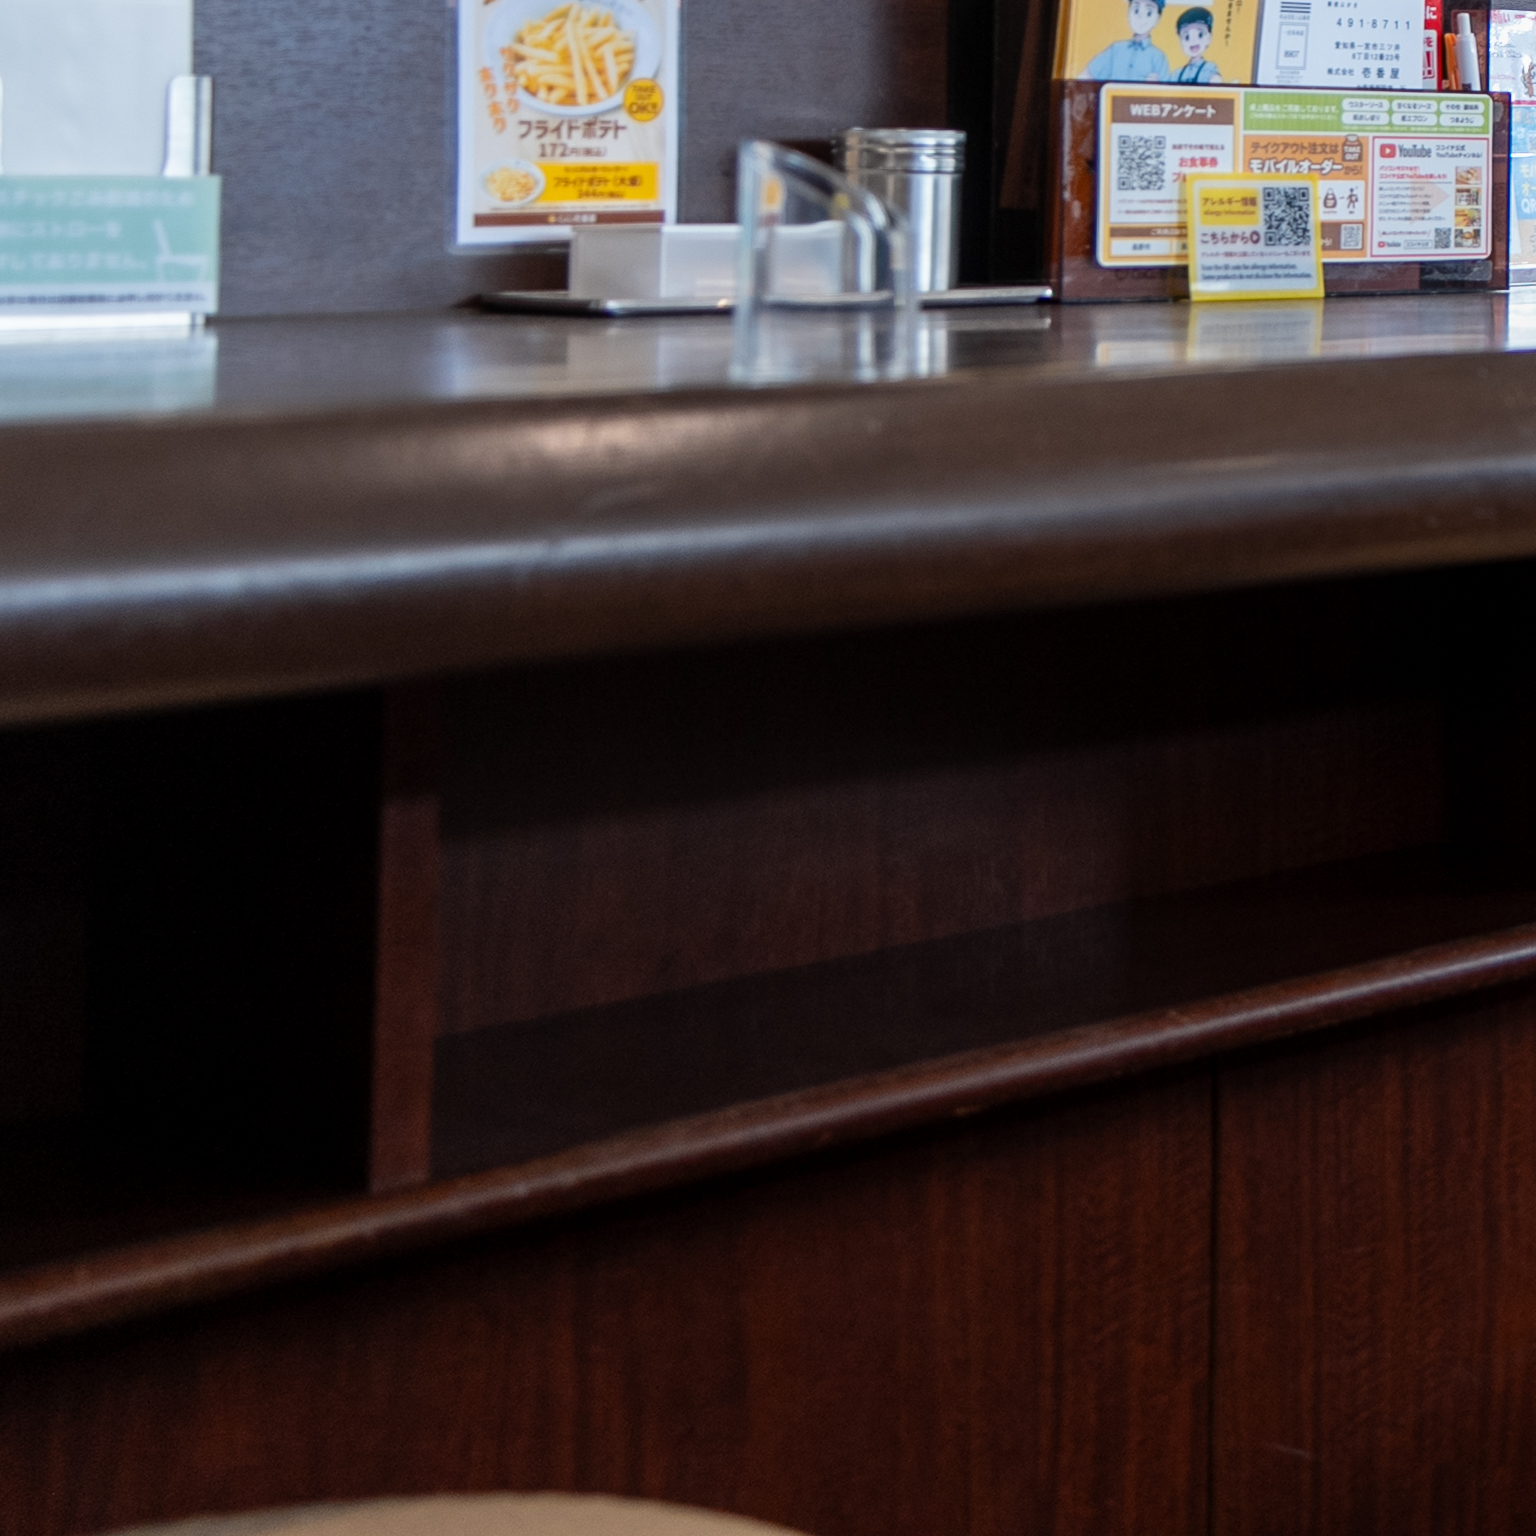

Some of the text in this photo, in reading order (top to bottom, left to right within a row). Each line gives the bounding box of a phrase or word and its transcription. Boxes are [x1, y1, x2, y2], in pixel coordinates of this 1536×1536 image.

[1336, 17, 1411, 31] 491-8711
[1129, 103, 1217, 117] WEBアンケート
[518, 117, 627, 139] フライドポテト
[1250, 142, 1339, 155] テイクアウト注文は
[1398, 144, 1432, 158] YouTube
[1249, 158, 1343, 175] モバイルオーダー
[1200, 230, 1250, 245] こちらから
